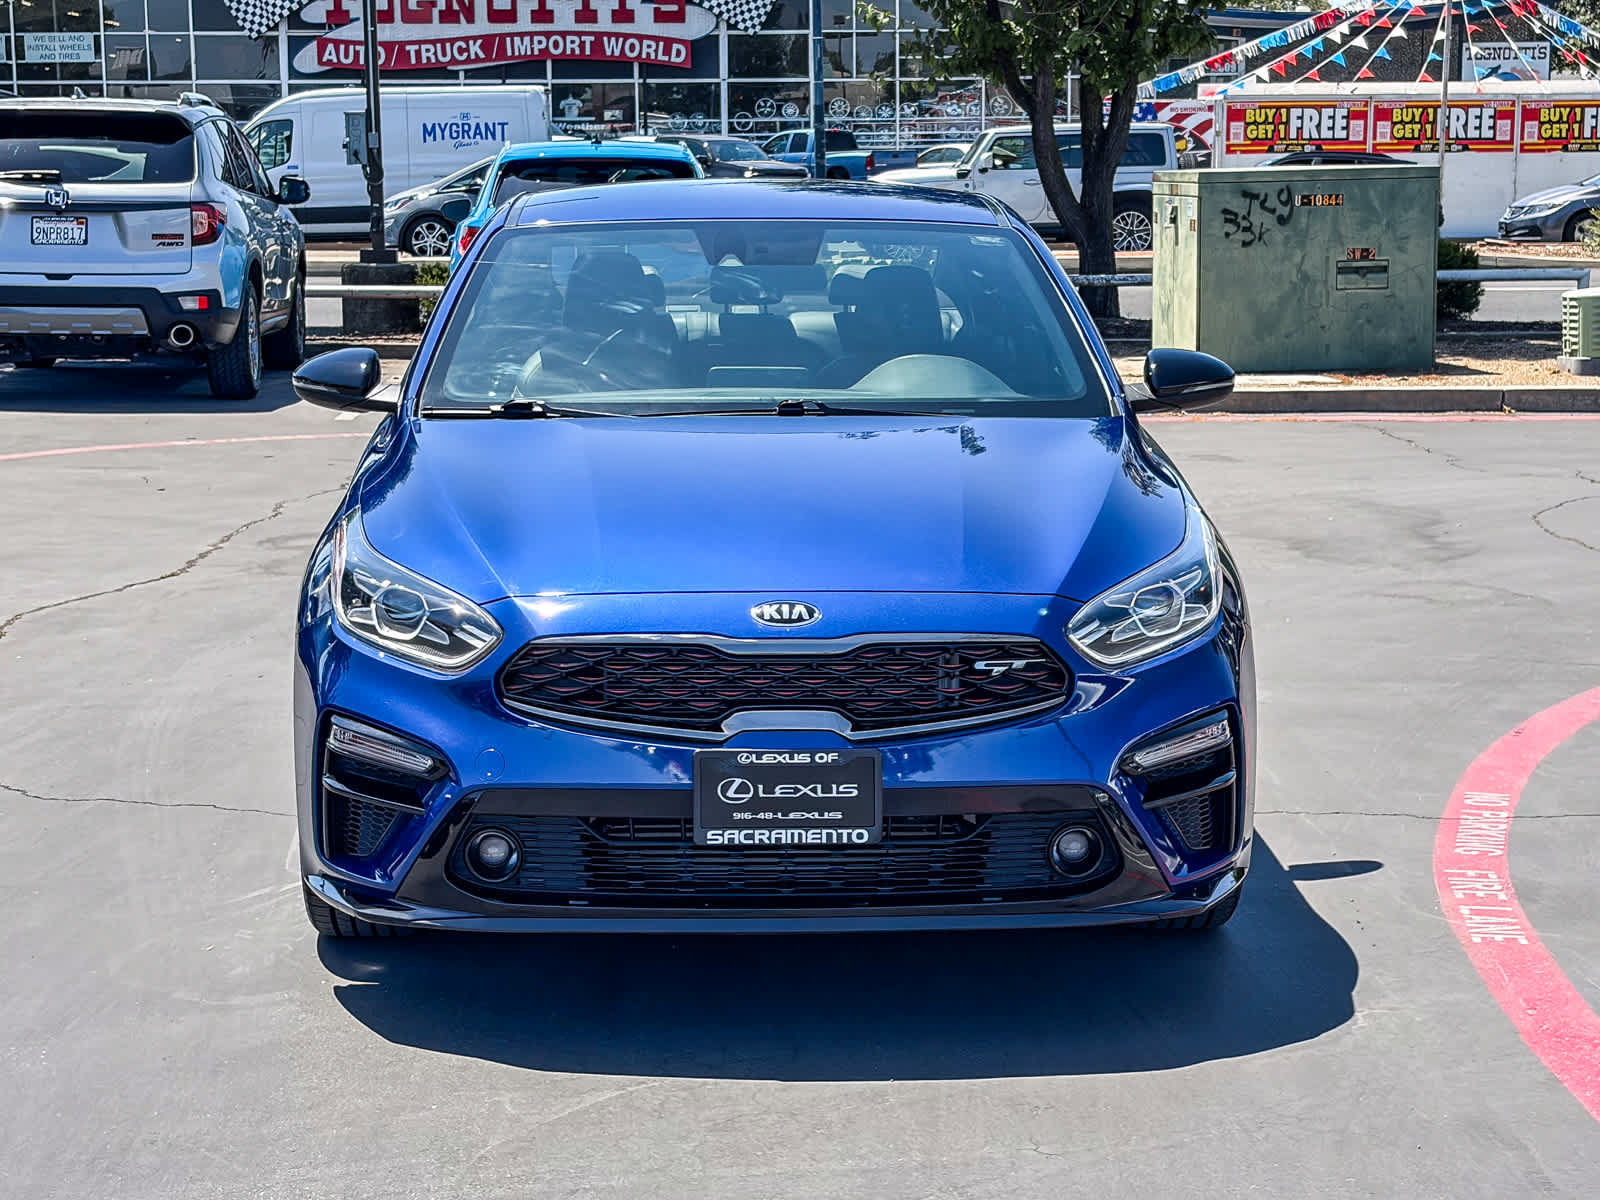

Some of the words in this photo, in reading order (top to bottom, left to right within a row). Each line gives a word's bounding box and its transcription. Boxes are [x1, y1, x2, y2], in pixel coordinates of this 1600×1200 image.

[33, 35, 47, 43] WE
[68, 34, 85, 42] AND
[60, 43, 92, 51] WHEELS
[405, 39, 486, 65] TRUCK
[505, 35, 595, 57] IMPORT
[603, 37, 687, 64] WORLD
[59, 52, 81, 60] TIRES
[1245, 108, 1276, 123] BUY
[1280, 108, 1287, 123] 1
[1392, 108, 1423, 122] BUY
[1427, 108, 1434, 122] 1
[1540, 107, 1571, 122] BUY
[1575, 107, 1582, 121] 1
[1289, 107, 1349, 139] FREE
[422, 122, 509, 143] MYGRANT
[1246, 124, 1275, 139] GET
[1279, 124, 1286, 139] 1
[1392, 124, 1421, 138] GET
[1425, 124, 1432, 138] 1
[1540, 124, 1569, 138] GET
[1573, 124, 1580, 137] 1
[1294, 194, 1344, 207] U-10844
[34, 226, 84, 241] 9NPR817
[1347, 248, 1376, 260] SW-2
[762, 603, 811, 620] KIA
[751, 753, 811, 764] LEXUS
[814, 753, 839, 763] OF
[757, 784, 858, 797] LEXUS
[1463, 791, 1511, 807] NO
[733, 811, 843, 820] 916-48-LEXUS
[706, 829, 869, 845] SACRAMENTO
[1454, 809, 1509, 856] PARKING
[1444, 869, 1508, 901] FIRE
[1459, 905, 1529, 945] LANE
